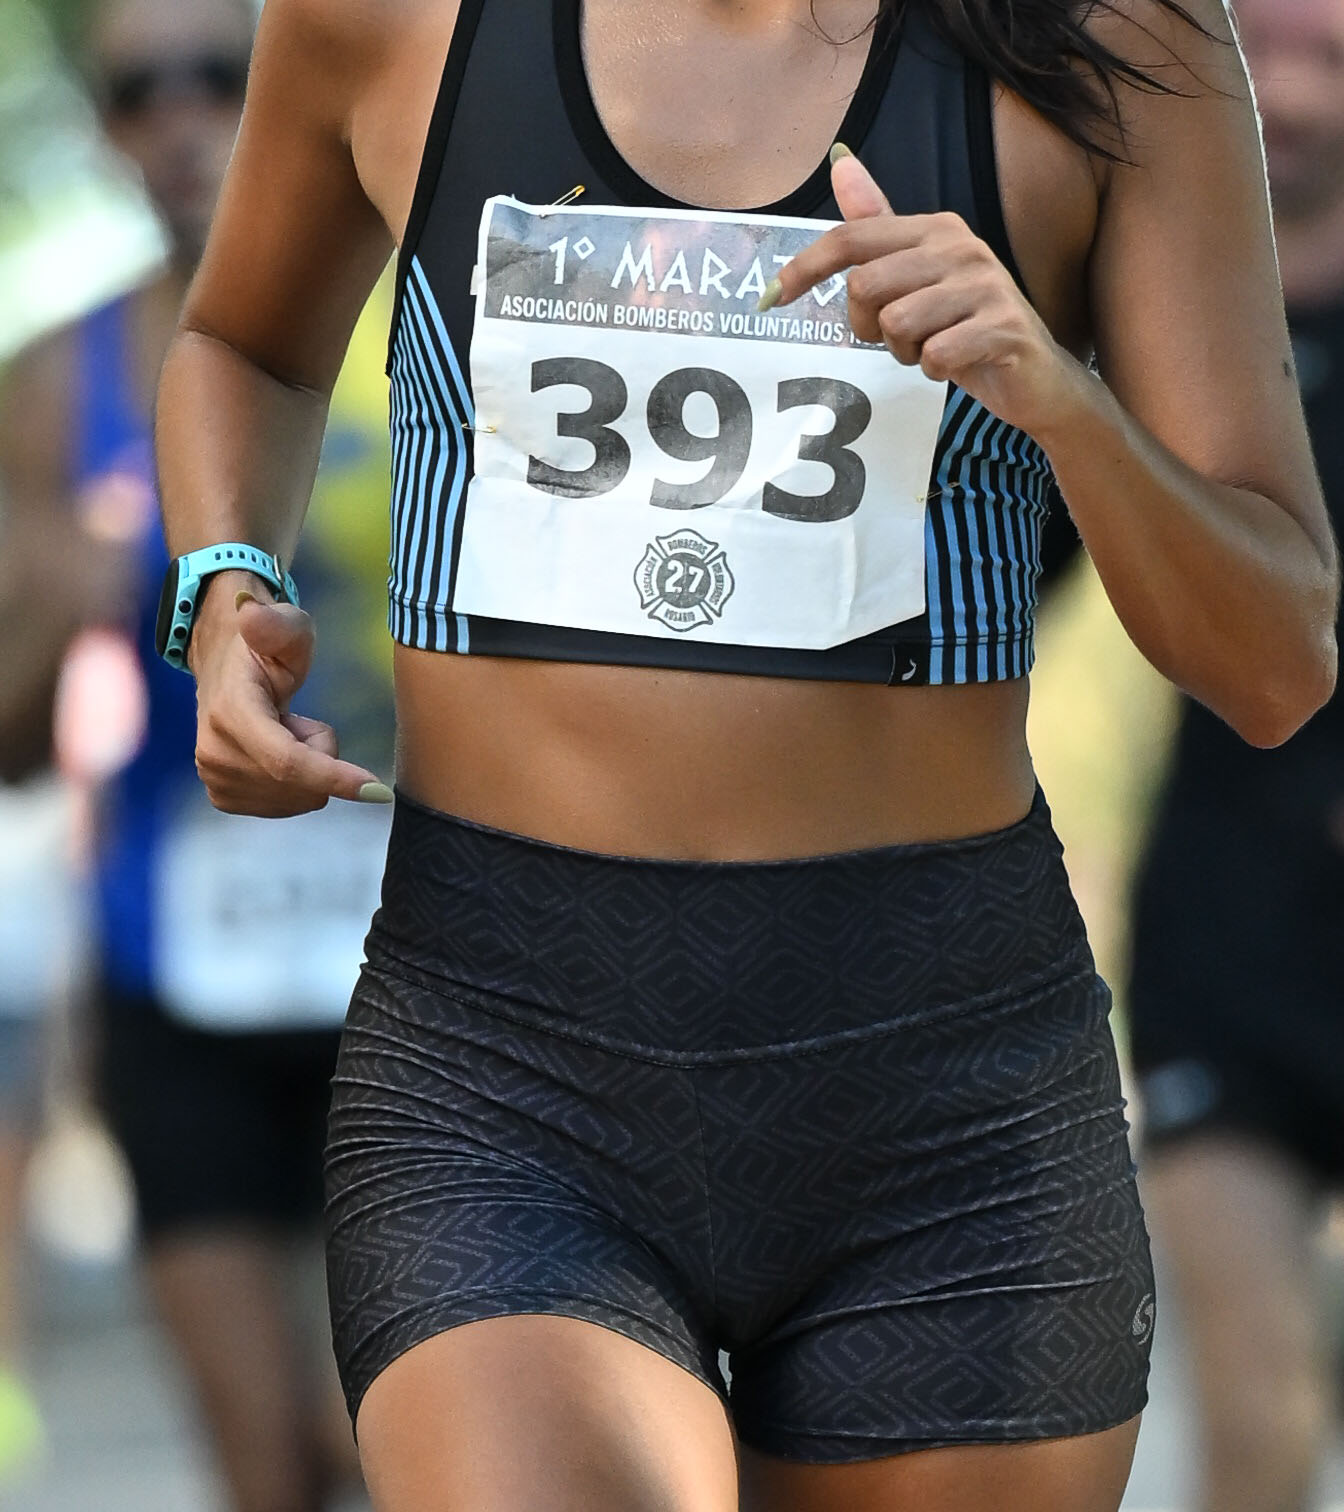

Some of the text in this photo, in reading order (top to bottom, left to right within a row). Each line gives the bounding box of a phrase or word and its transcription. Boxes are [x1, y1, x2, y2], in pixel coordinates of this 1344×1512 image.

[610, 240, 846, 307] MARA
[500, 294, 608, 324] ASOCIACIÓN
[613, 305, 714, 332] BOMBEROS
[719, 313, 845, 343] VOLUNTARIOS
[526, 356, 872, 523] 393
[664, 559, 705, 593] 27
